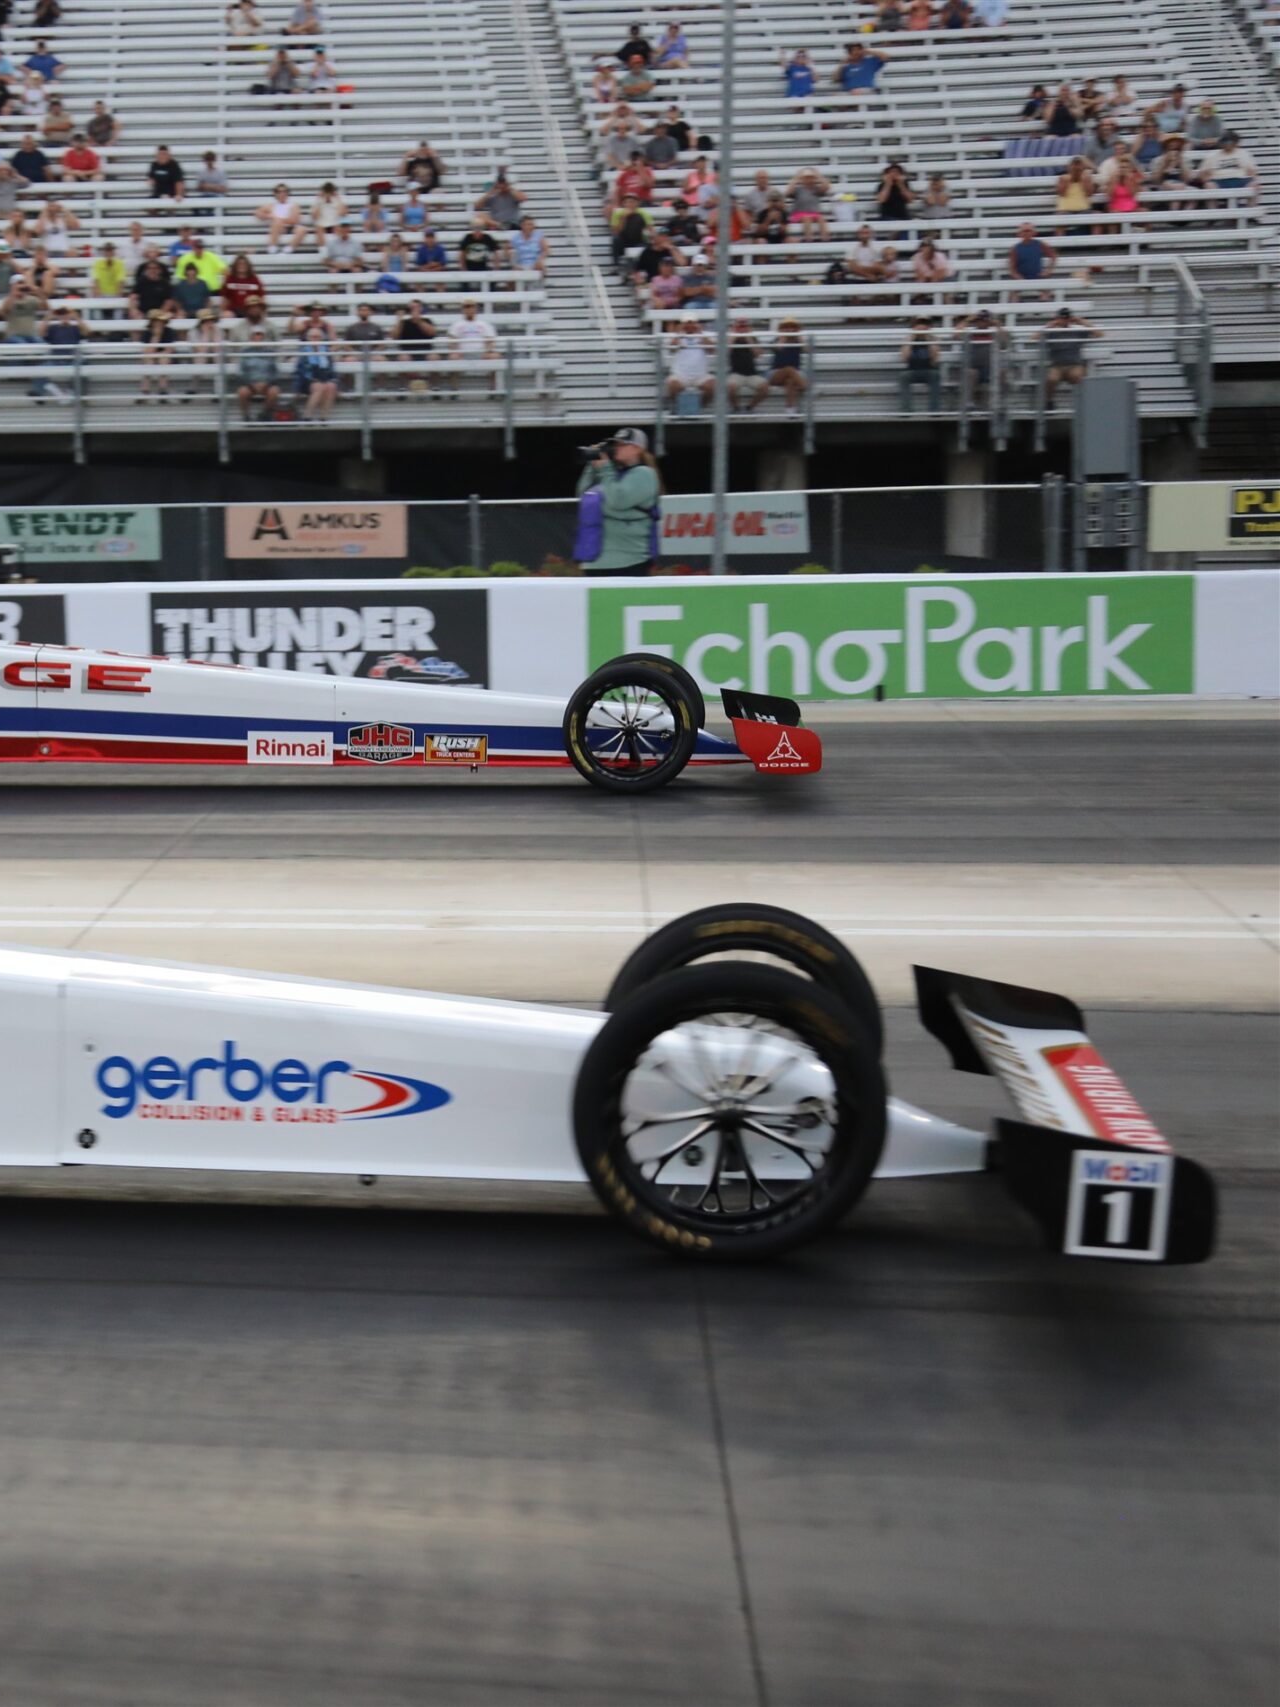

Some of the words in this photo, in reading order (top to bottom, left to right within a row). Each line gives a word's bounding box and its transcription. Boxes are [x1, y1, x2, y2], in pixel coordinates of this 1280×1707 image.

[6, 512, 136, 536] FENDT
[298, 513, 381, 529] AMKUS
[663, 512, 730, 537] LUCA
[732, 511, 768, 536] OIL
[154, 607, 438, 651] THUNDER
[623, 586, 1154, 697] EchoPark
[351, 725, 412, 746] JHG
[256, 739, 326, 757] Rinnai
[358, 752, 404, 760] GARAGE
[97, 1040, 353, 1119] gerber
[138, 1103, 244, 1121] COLLISION
[276, 1106, 338, 1124] GLASS
[1083, 1158, 1160, 1183] Mobil
[1101, 1191, 1133, 1245] 1
